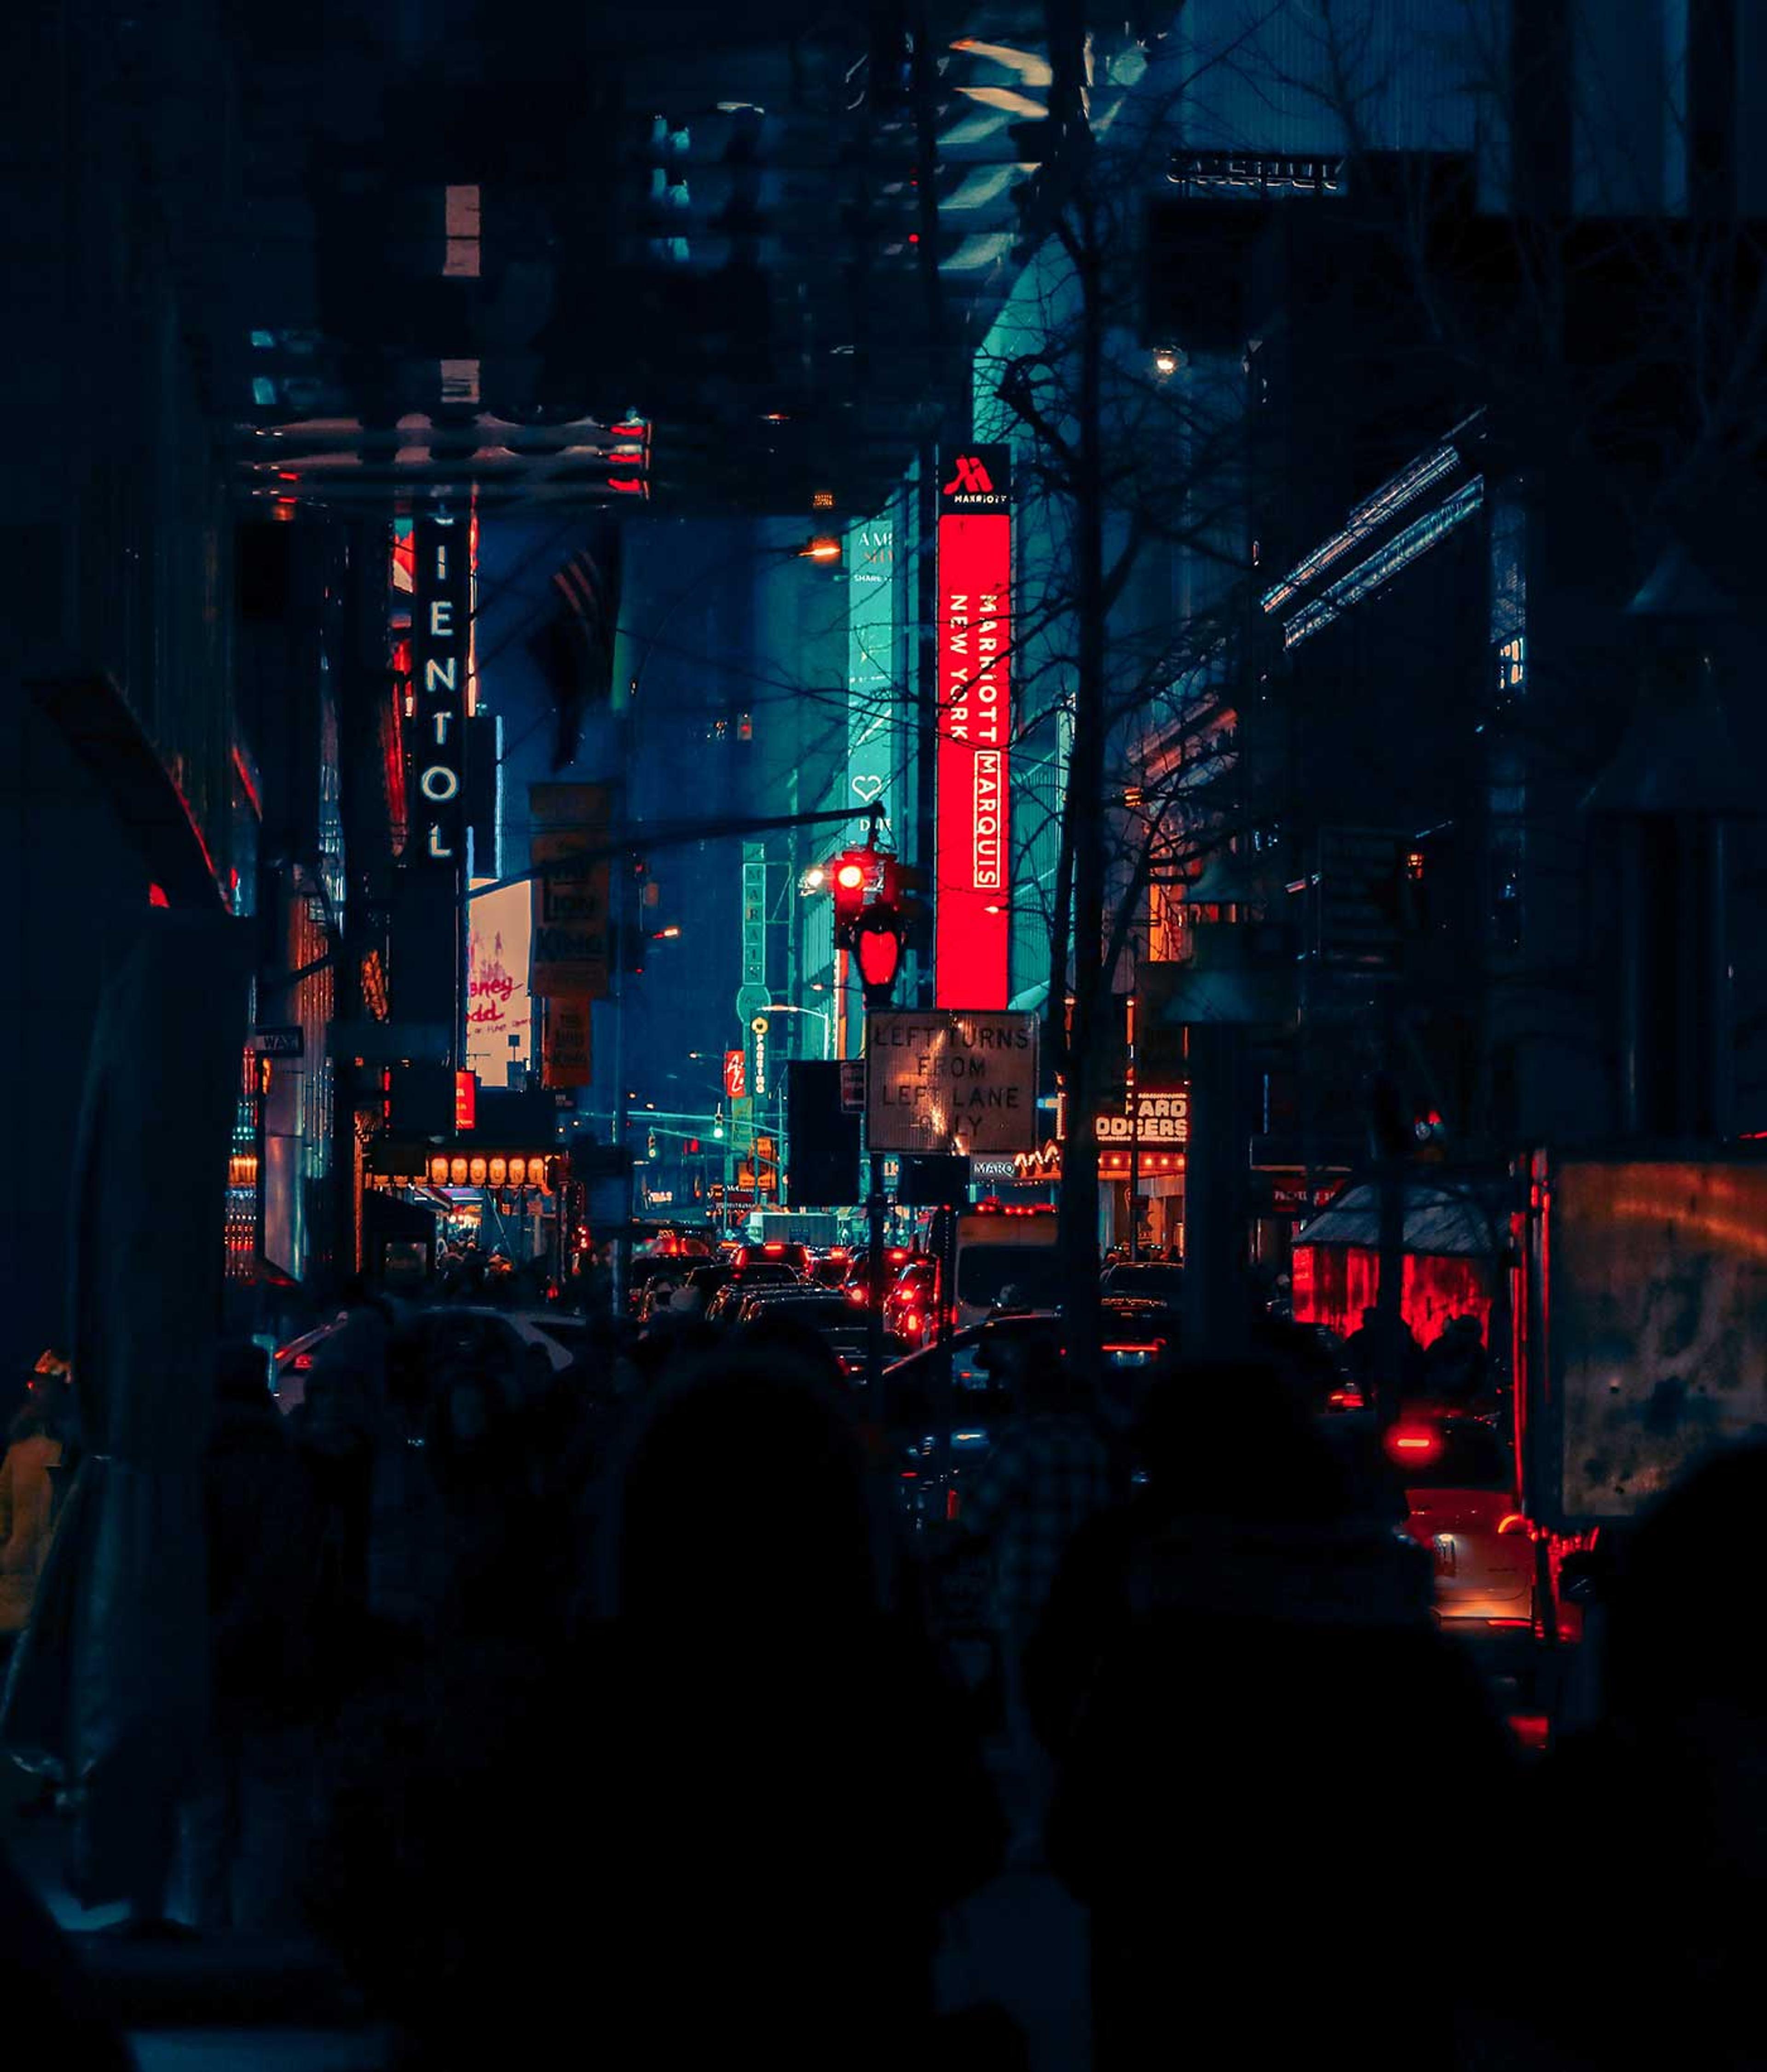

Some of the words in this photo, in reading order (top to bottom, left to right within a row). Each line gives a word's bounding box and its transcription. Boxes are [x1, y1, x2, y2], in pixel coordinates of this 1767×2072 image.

[950, 594, 968, 655] NEW
[979, 594, 998, 742] MARRIOTT
[950, 668, 969, 741] YORK
[977, 756, 997, 884] MARQUIS
[876, 1027, 935, 1048] LEFT
[946, 1028, 1028, 1048] TURNS
[918, 1056, 985, 1078] FROM
[883, 1085, 942, 1106] LEFT
[953, 1088, 1019, 1108] LANE
[920, 1115, 983, 1137] OLY
